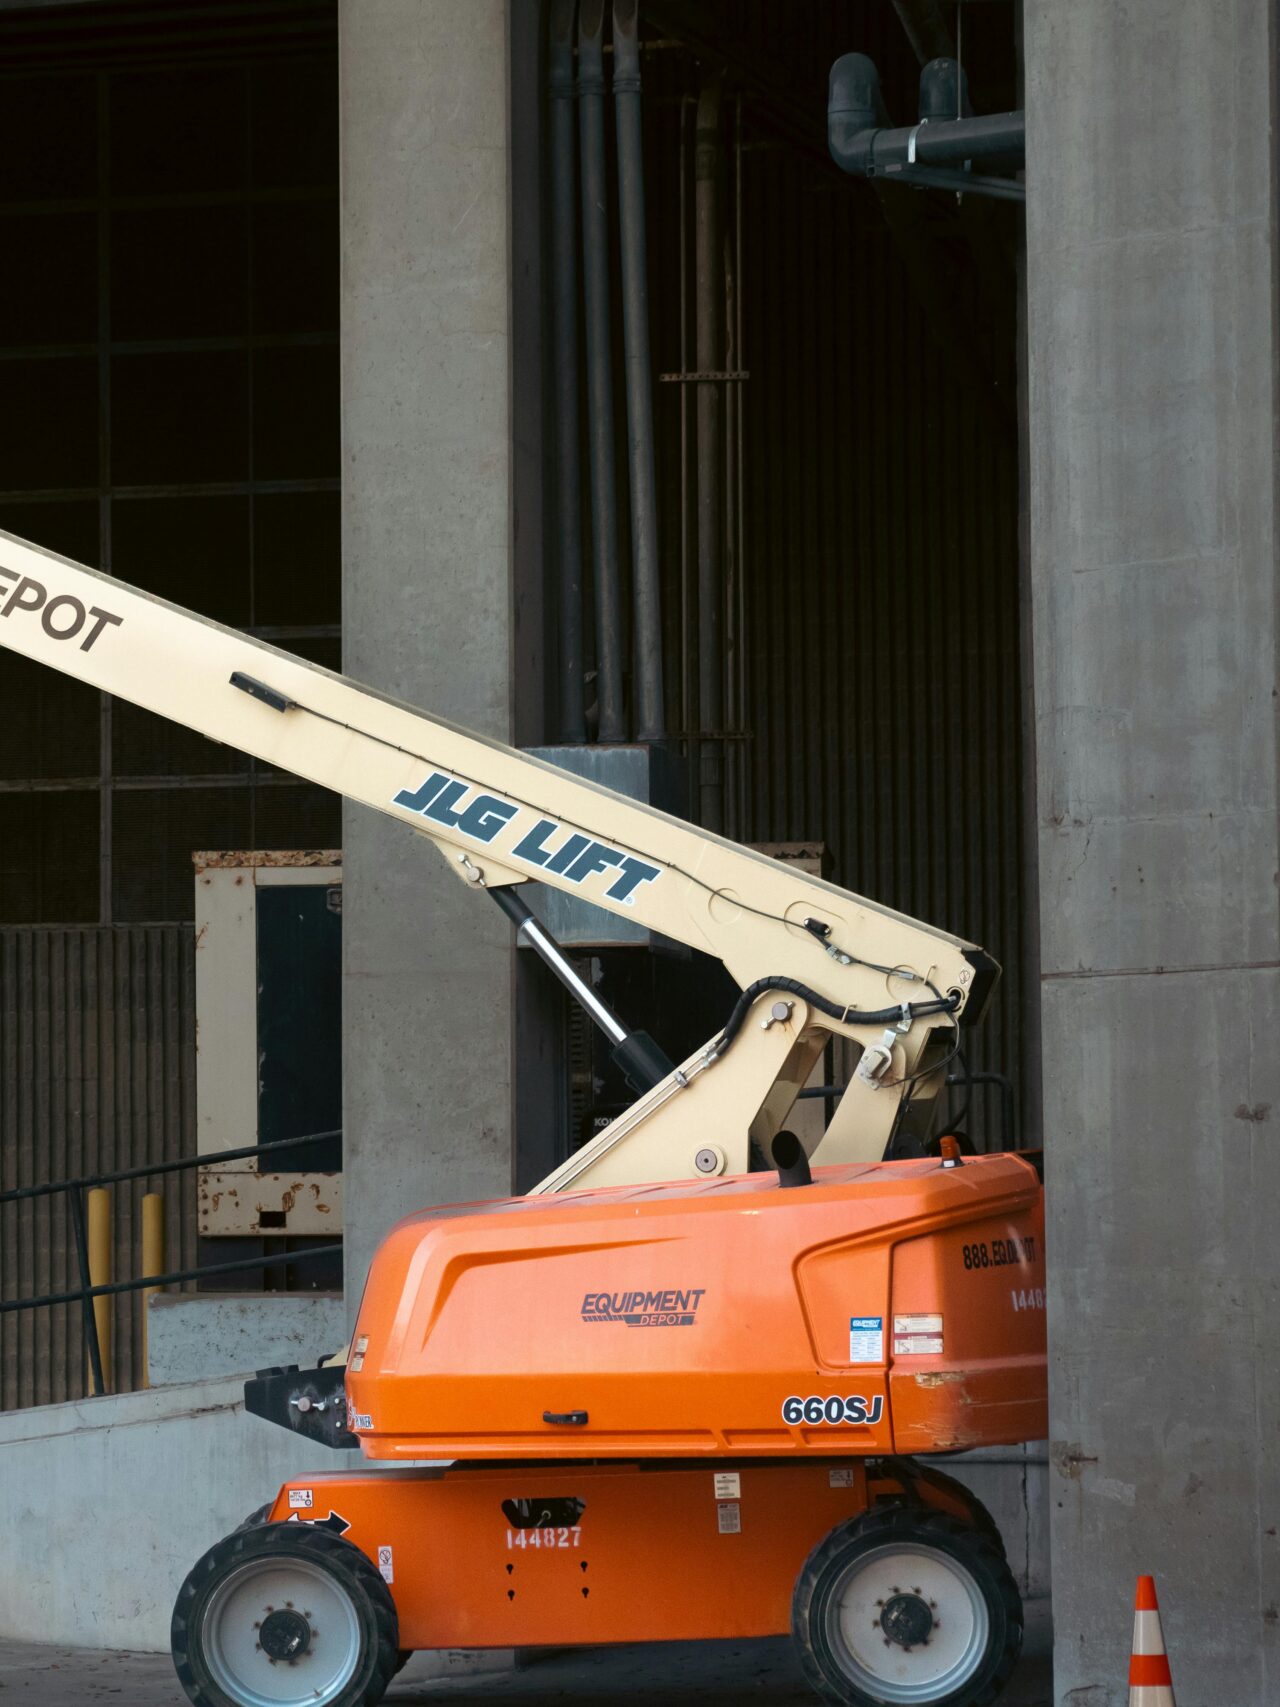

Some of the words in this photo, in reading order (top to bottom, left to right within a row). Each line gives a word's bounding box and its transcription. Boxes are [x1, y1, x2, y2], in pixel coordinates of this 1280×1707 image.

[392, 772, 520, 843] JLG
[511, 819, 662, 902] LIFT
[581, 1289, 706, 1318] EQUIPMENT
[1011, 1288, 1047, 1312] 1448
[639, 1313, 683, 1326] DEPOT
[782, 1395, 884, 1425] 660SJ
[506, 1525, 582, 1550] 144827
